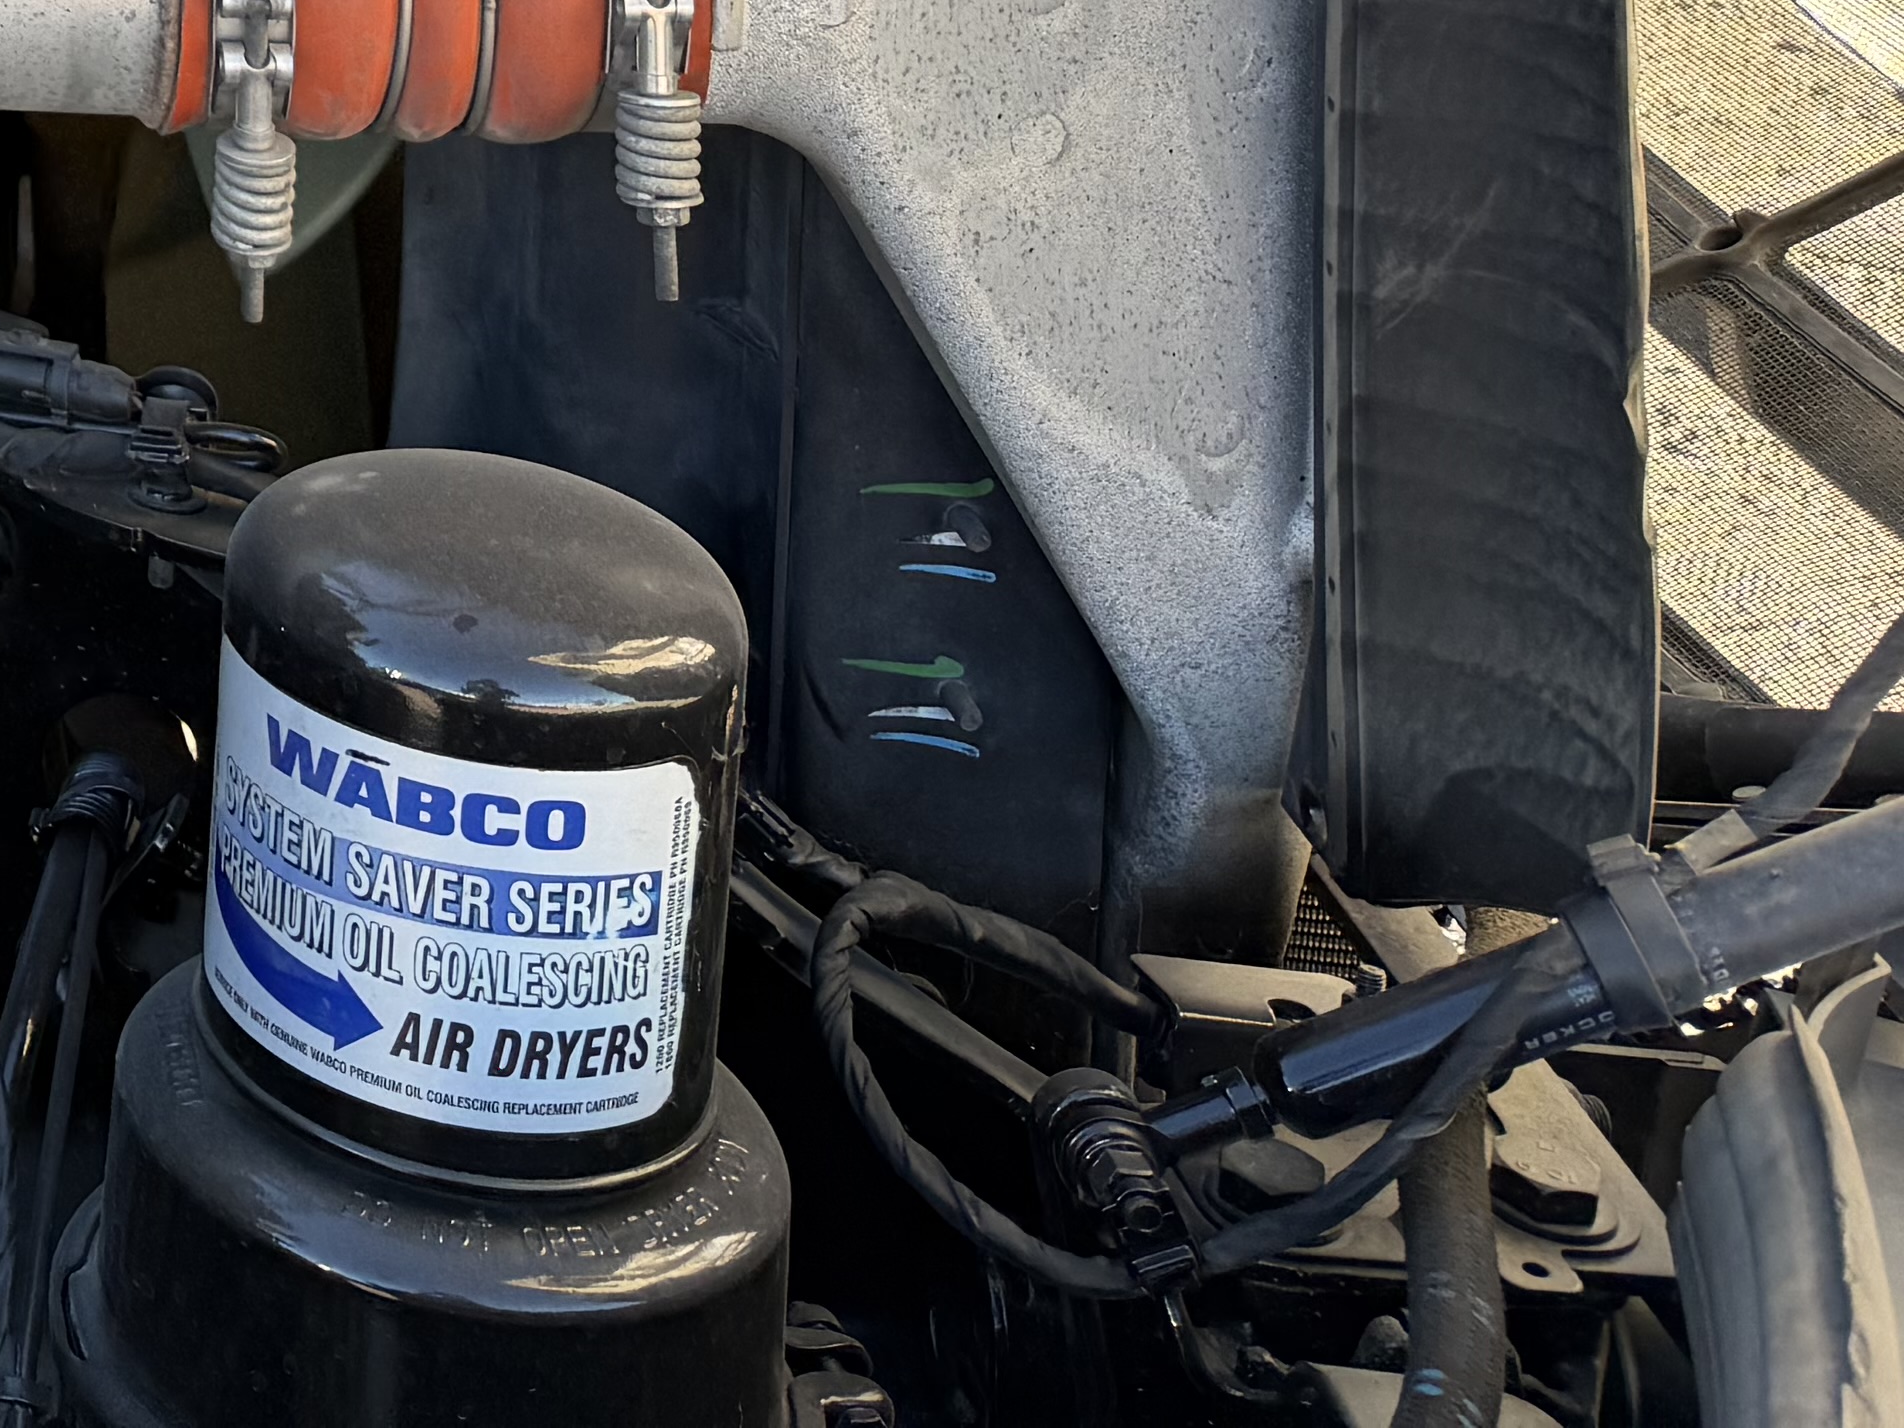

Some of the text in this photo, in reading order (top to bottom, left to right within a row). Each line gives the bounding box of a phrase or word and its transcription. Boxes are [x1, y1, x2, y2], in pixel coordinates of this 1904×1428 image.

[225, 754, 653, 937] SYSTEM SAVER SERIES
[266, 712, 587, 851] WABCO
[219, 823, 650, 1009] PREMIUM OIL COALESCING
[310, 1045, 347, 1075] WABCO
[349, 1064, 403, 1095] PREMIUM
[405, 1083, 424, 1101] OIL
[426, 1088, 500, 1115] COALESCING
[502, 1100, 584, 1117] REPLACEMENT
[585, 1090, 640, 1114] CARTRIDGE
[390, 1010, 653, 1081] AIR DRYERS
